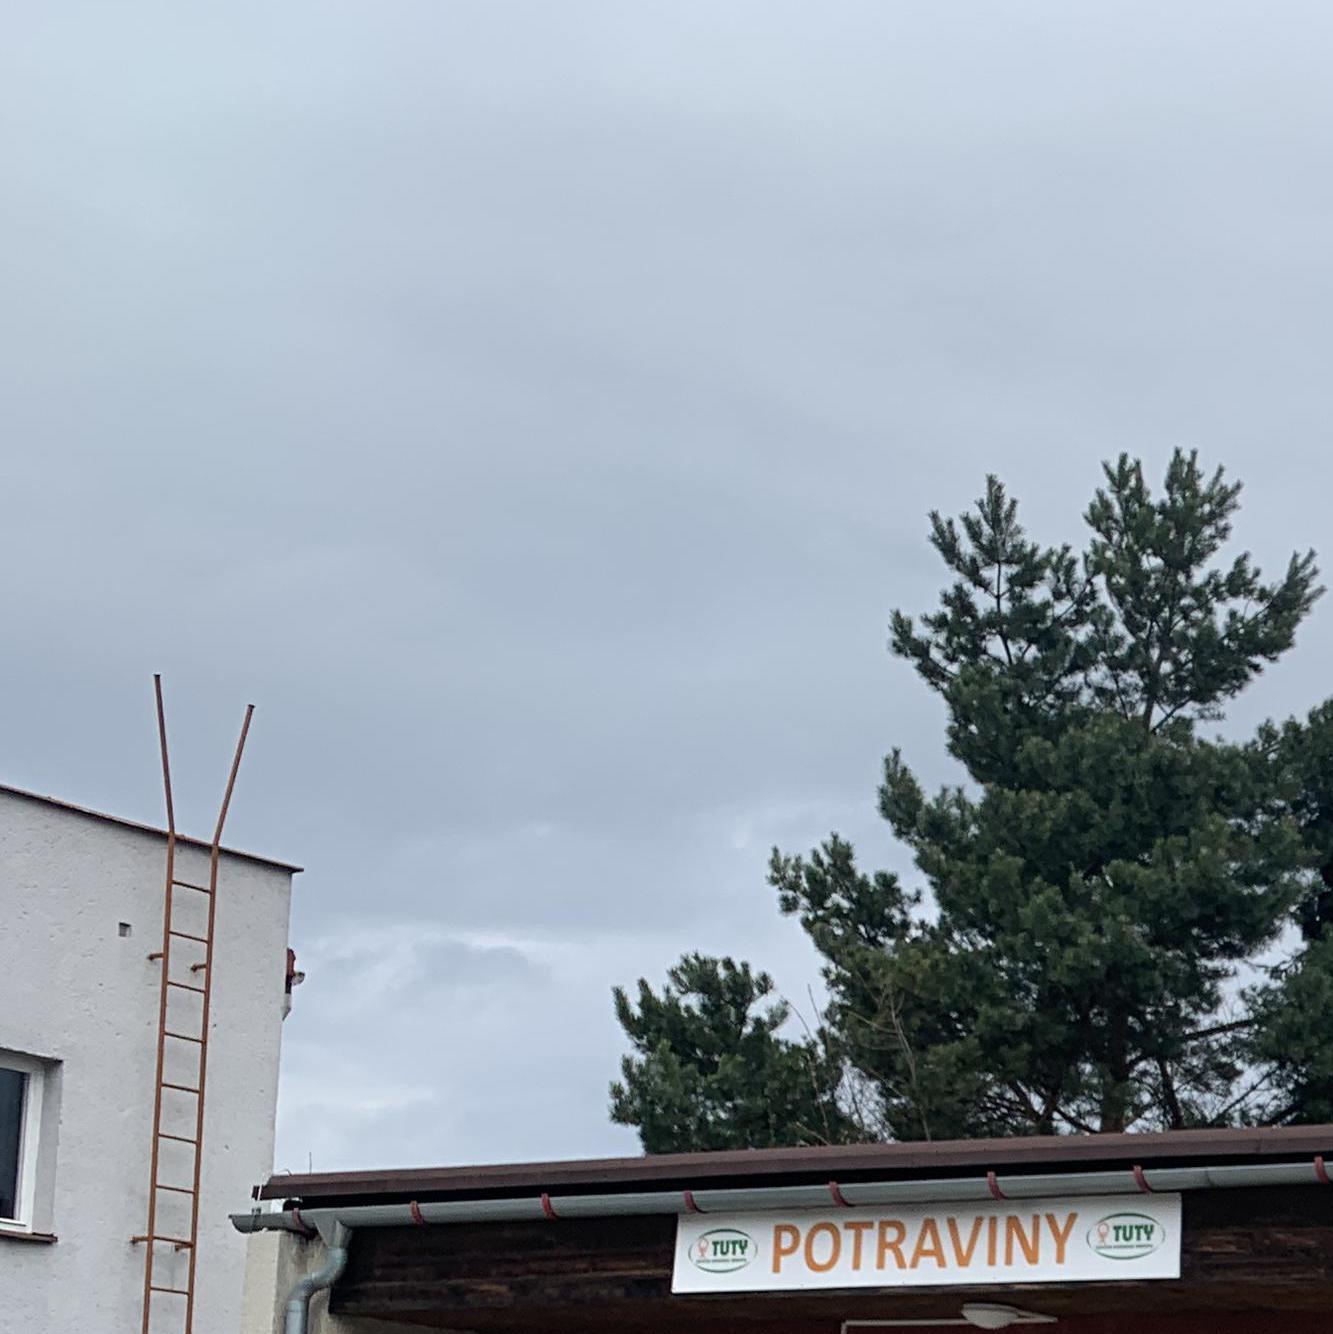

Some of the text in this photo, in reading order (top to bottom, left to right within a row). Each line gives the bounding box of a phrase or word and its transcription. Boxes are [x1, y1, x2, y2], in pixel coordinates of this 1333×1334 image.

[1113, 1225, 1154, 1242] TUTY
[712, 1240, 748, 1256] TUTY
[771, 1212, 1079, 1274] POTRAVINY
